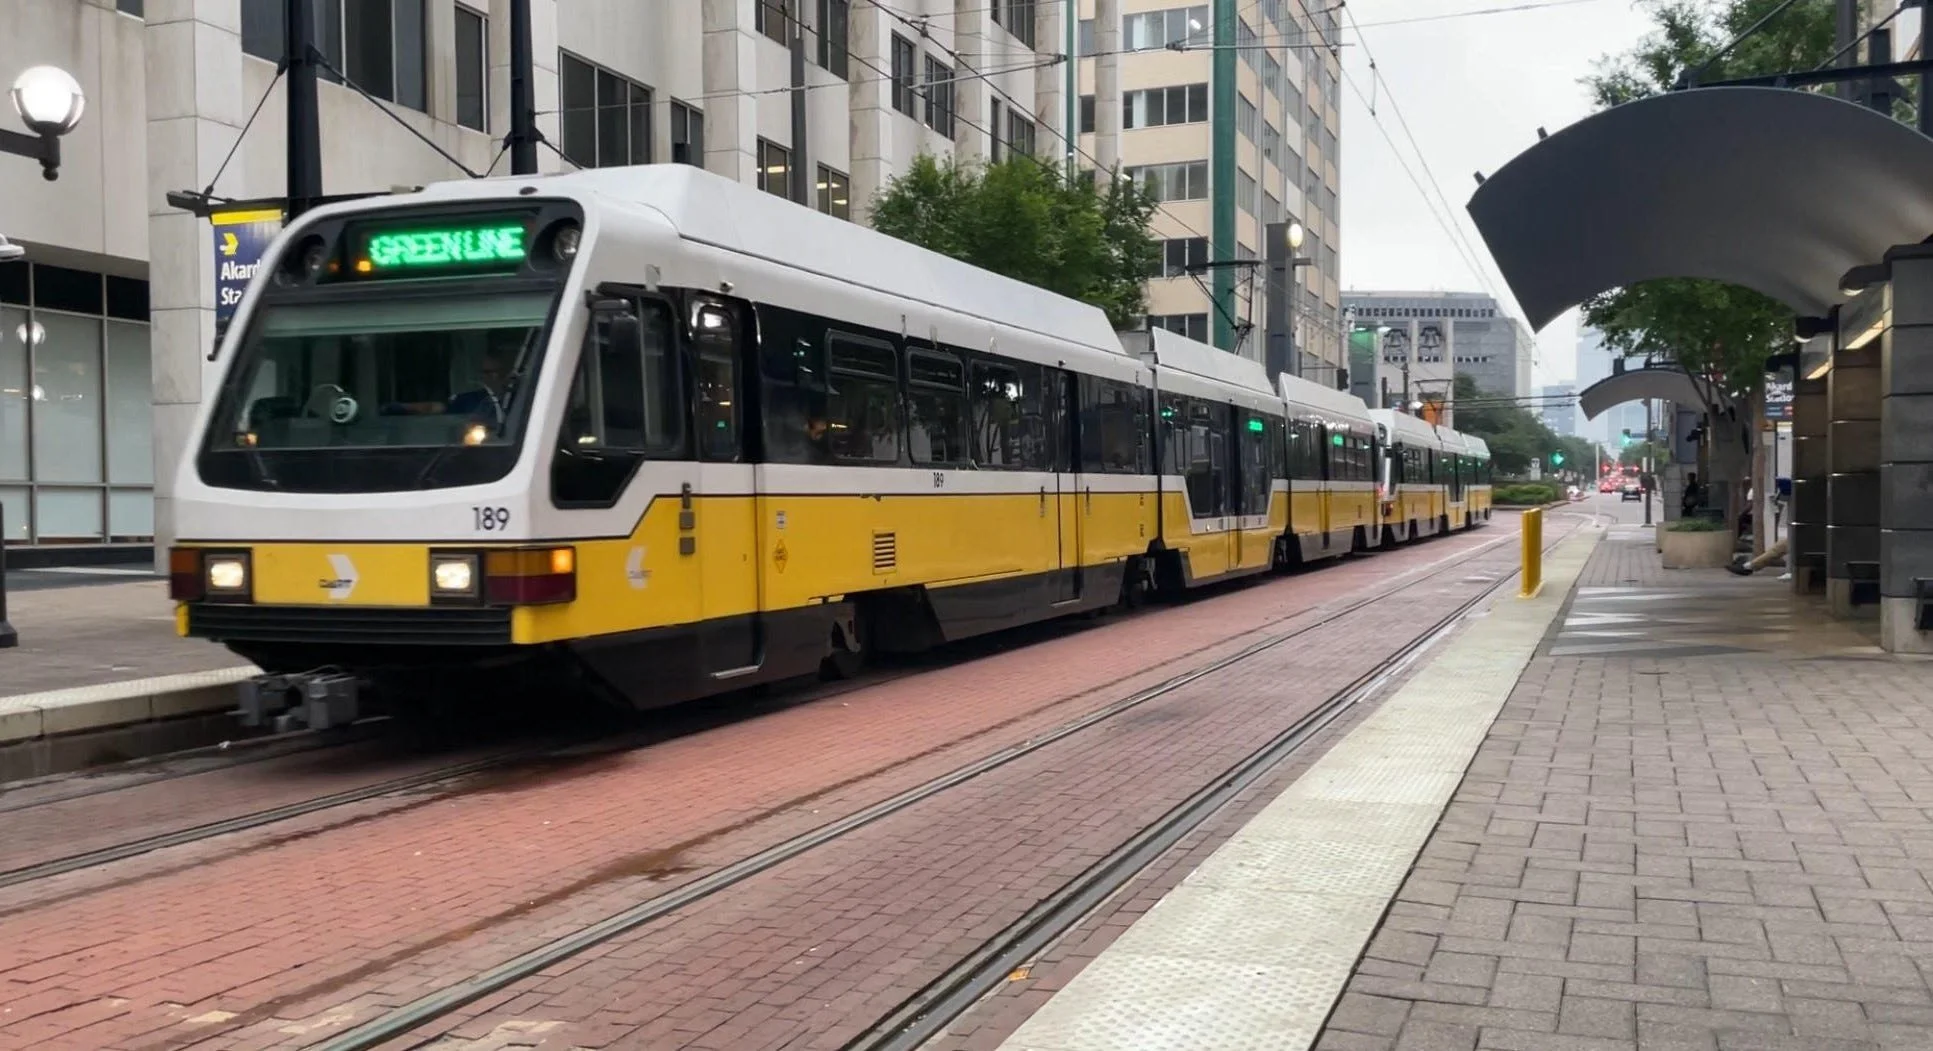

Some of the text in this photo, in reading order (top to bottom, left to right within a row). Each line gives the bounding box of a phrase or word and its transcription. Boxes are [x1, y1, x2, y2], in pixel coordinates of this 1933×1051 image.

[369, 226, 526, 266] GREEN LINE
[934, 471, 944, 488] 189
[472, 506, 510, 531] 189
